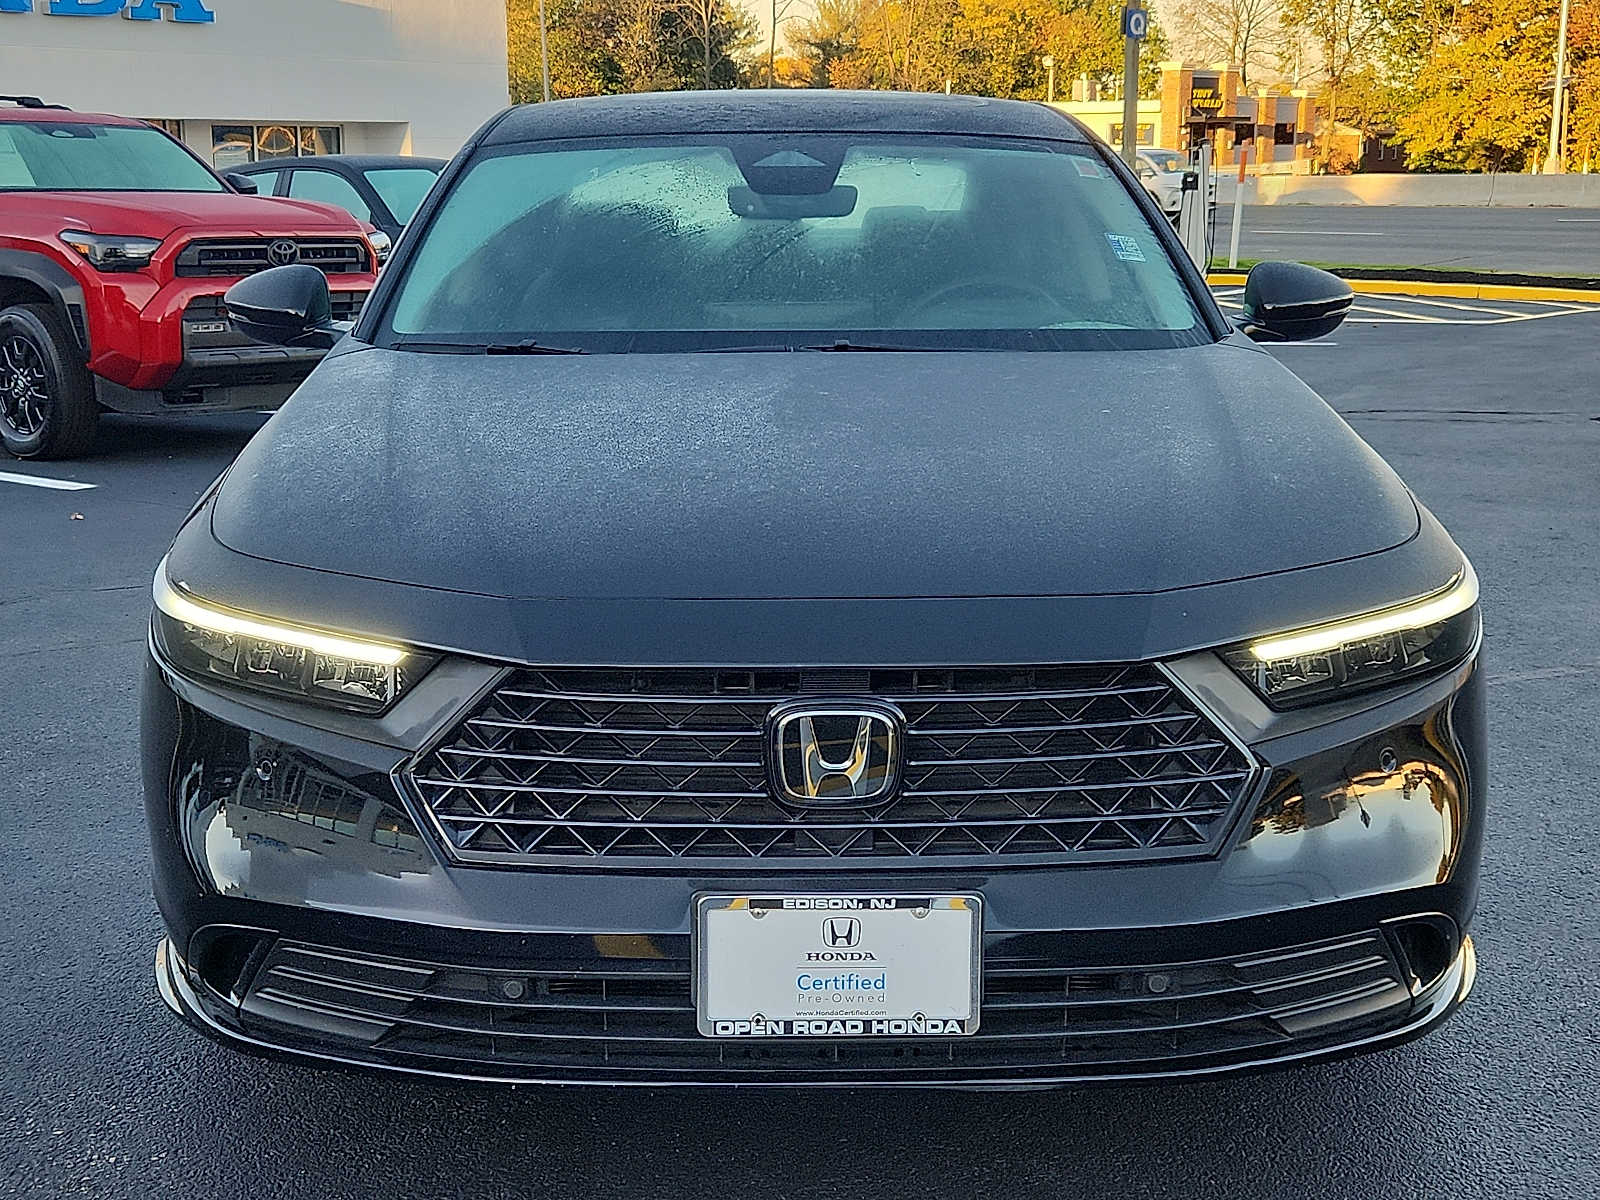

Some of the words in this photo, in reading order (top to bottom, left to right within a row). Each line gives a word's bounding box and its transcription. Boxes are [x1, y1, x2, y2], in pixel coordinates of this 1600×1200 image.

[1130, 13, 1145, 35] Q
[1191, 99, 1222, 108] WORLD
[783, 898, 863, 910] EDISON,
[870, 898, 896, 910] NJ
[805, 952, 878, 962] HONDA
[797, 972, 886, 991] Certified
[798, 992, 886, 1004] Pre-Owned
[795, 1009, 887, 1017] www.HondaCertified.com
[715, 1020, 785, 1035] OPEN
[793, 1020, 864, 1035] ROAD
[871, 1020, 962, 1034] HONDA
